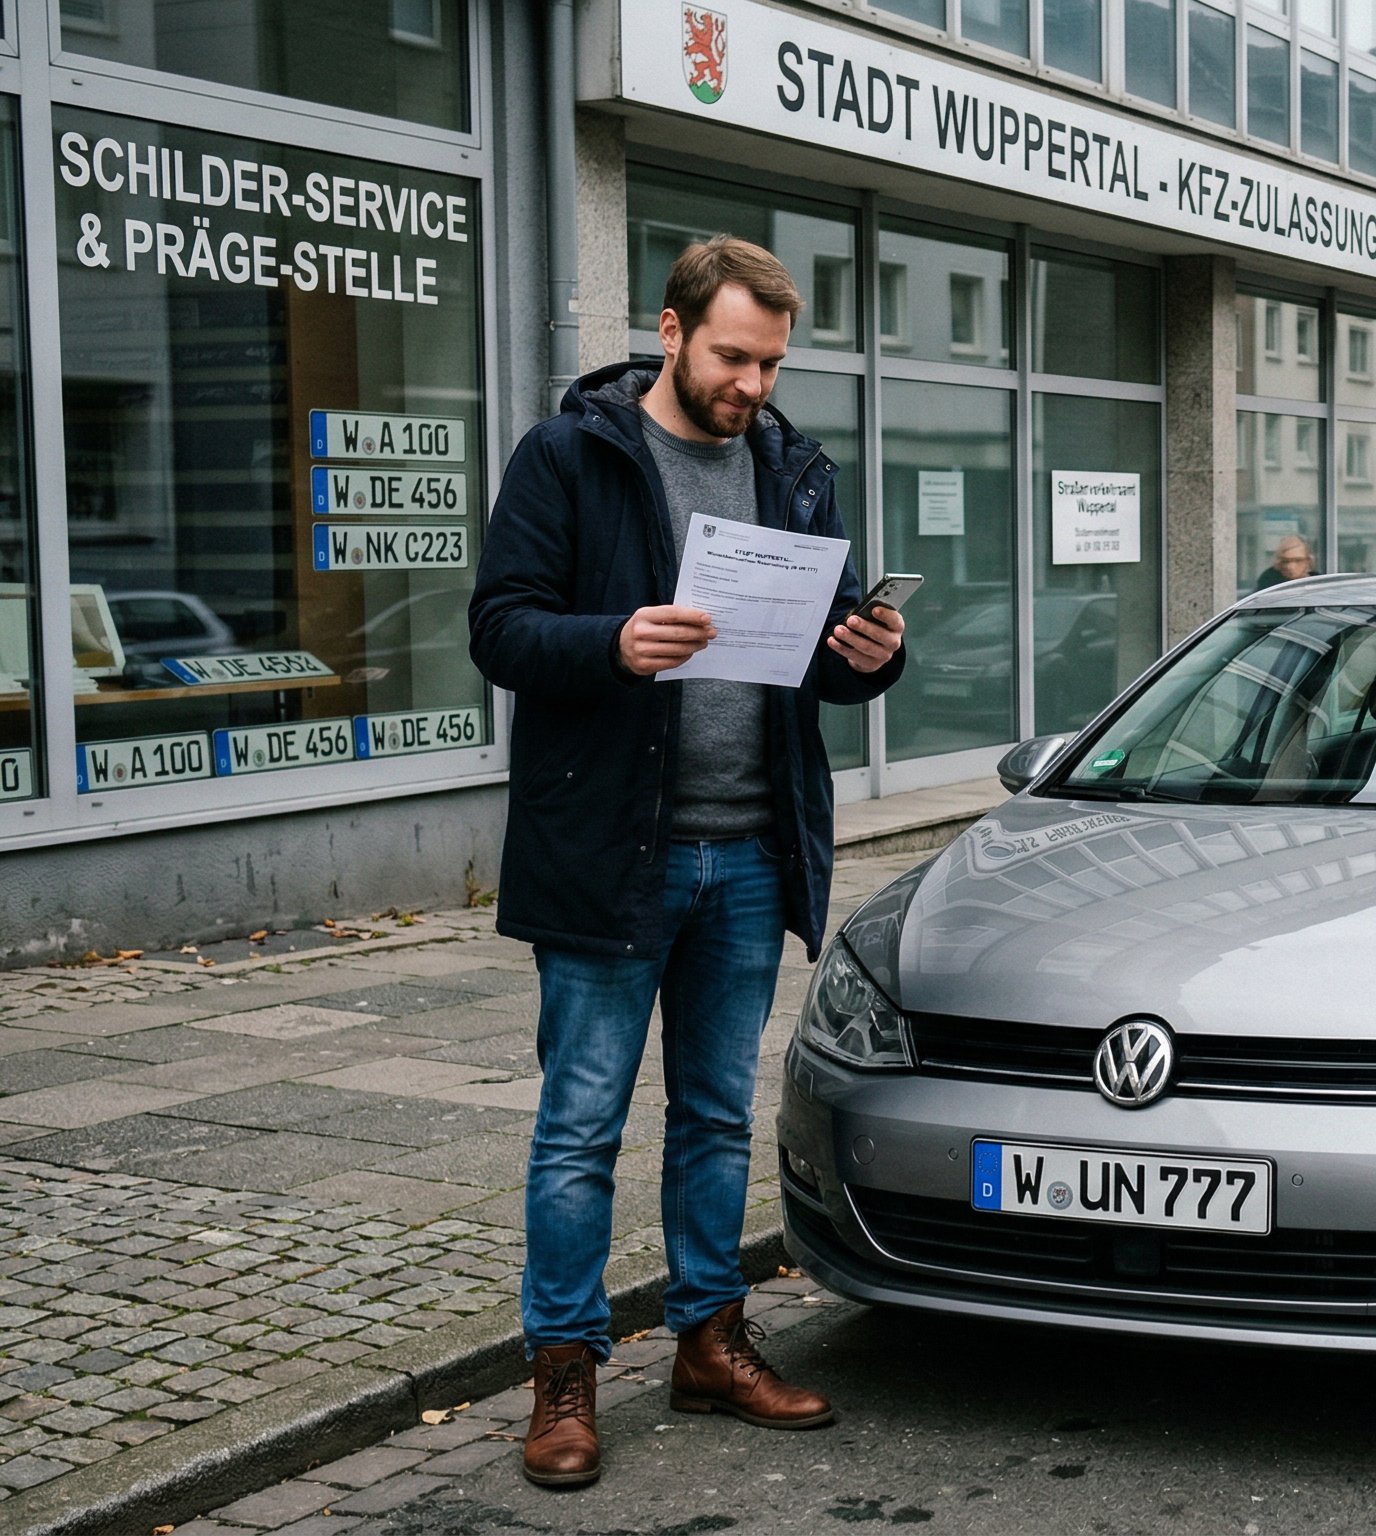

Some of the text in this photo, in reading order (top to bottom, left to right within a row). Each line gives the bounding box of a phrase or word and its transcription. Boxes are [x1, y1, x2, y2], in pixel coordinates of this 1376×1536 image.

[777, 41, 920, 141] STADT
[932, 85, 1148, 201] WUPPERTAL
[59, 131, 468, 243] SCHILDER-SERVICE
[76, 212, 438, 305] & PRÄGE-STELLE
[317, 440, 323, 449] D
[342, 419, 359, 453] W
[318, 475, 457, 509] D W DE 456
[332, 532, 348, 564] W
[366, 532, 399, 563] NK
[183, 661, 211, 679] W
[216, 658, 262, 678] DE
[220, 725, 348, 768] D W DE 456
[372, 721, 385, 751] W
[401, 717, 430, 748] DE
[436, 712, 475, 743] 456
[91, 749, 109, 783] W
[982, 1154, 1256, 1222] D W UN 777
